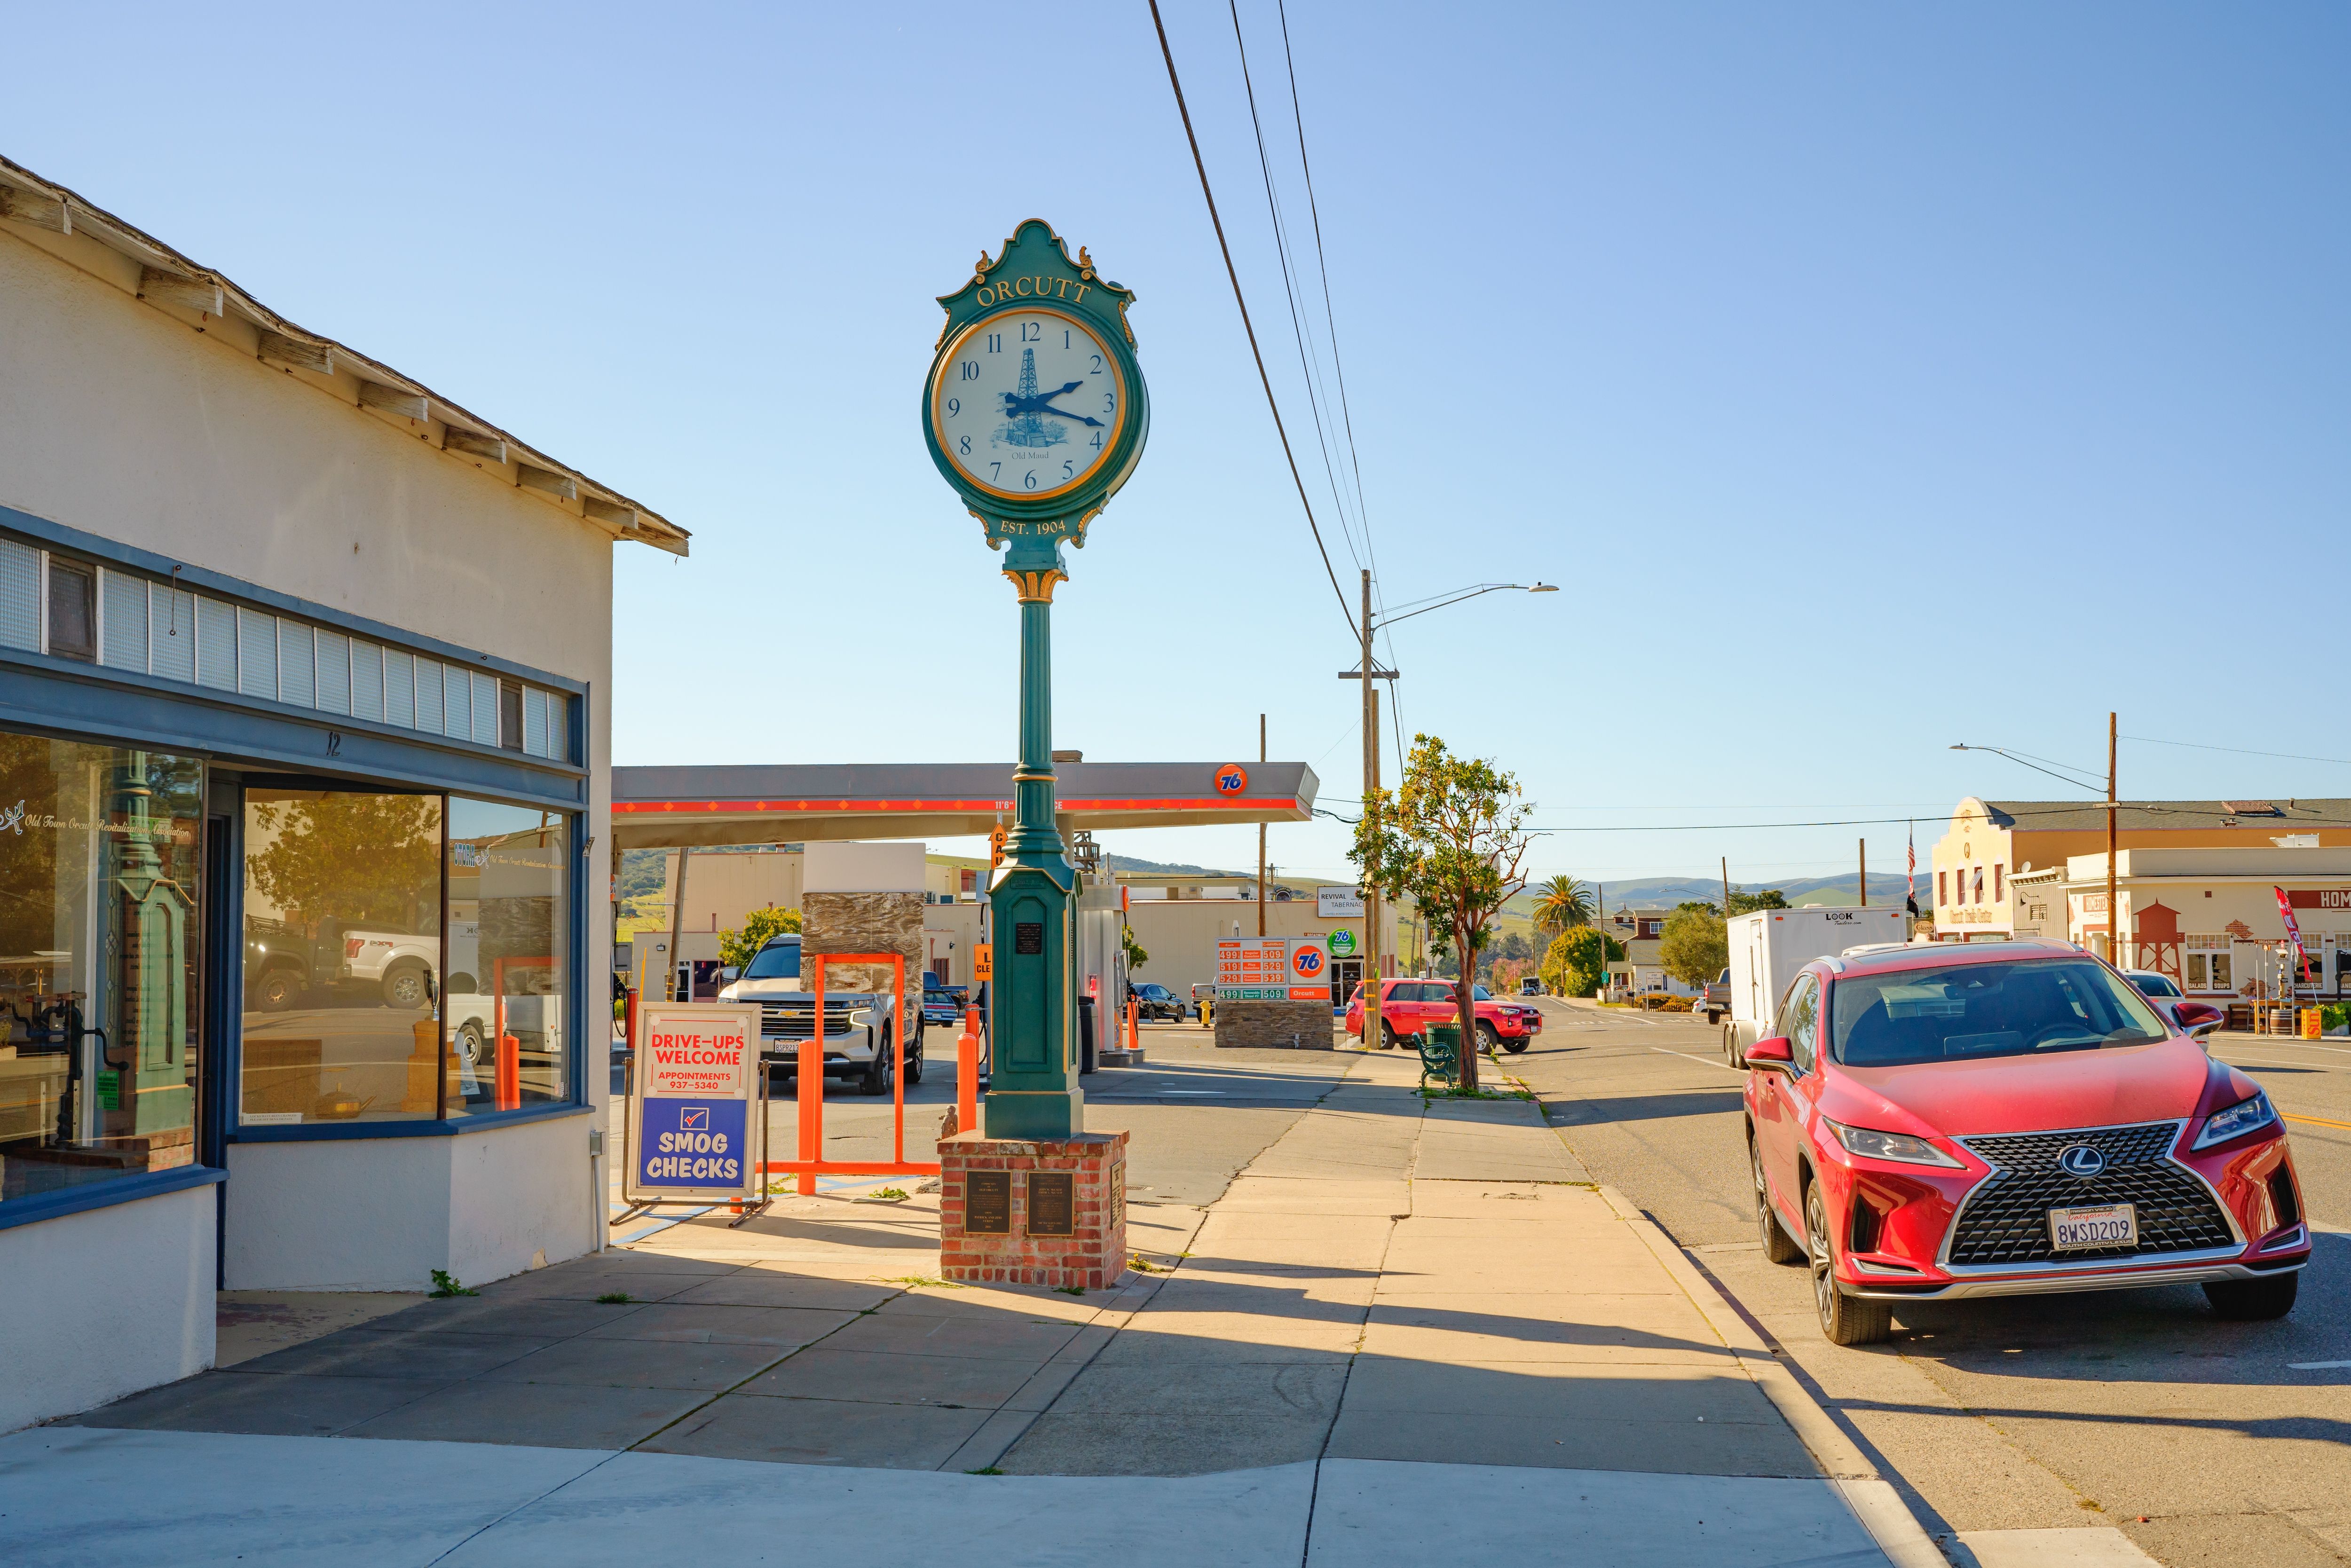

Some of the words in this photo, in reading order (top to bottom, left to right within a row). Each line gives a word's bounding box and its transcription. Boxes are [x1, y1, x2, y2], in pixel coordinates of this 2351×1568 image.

[977, 276, 1091, 307] ORCUTT
[1020, 322, 1041, 342] 12
[1064, 330, 1071, 350] 1
[988, 333, 1002, 354] 11
[961, 361, 979, 381] 10
[1089, 355, 1103, 375] 2
[948, 398, 960, 418] 9
[1103, 393, 1114, 413] 3
[960, 435, 971, 455] 8
[1089, 431, 1103, 451] 4
[1011, 451, 1026, 460] Old
[1028, 451, 1049, 459] Maud
[989, 462, 1002, 482] 7
[1024, 469, 1037, 489] 6
[1063, 460, 1073, 480] 5
[1000, 520, 1030, 535] EST.
[1036, 519, 1066, 536] 1904
[326, 732, 340, 756] 12
[1219, 772, 1242, 790] 76
[25, 814, 41, 827] Old
[43, 815, 66, 828] Town
[68, 817, 94, 830] Orcutt
[95, 819, 148, 834] Revitalization
[147, 823, 190, 837] Association
[454, 843, 475, 867] OTORA
[497, 855, 508, 865] Town
[509, 857, 521, 866] Orcutt
[521, 858, 546, 868] Revitalization
[2086, 895, 2108, 911] HOMESTEA
[1335, 930, 1349, 942] 76
[1297, 952, 1320, 971] 76
[2308, 1012, 2320, 1035] Sun
[652, 1034, 744, 1049] DRIVE-UPS
[655, 1050, 740, 1065] WELCOME
[658, 1072, 731, 1080] APPOINTMENTS
[670, 1081, 718, 1090] 937-5340
[658, 1132, 728, 1154] SMOG
[647, 1156, 738, 1179] CHECKS
[2068, 1212, 2118, 1222] California
[2058, 1220, 2130, 1243] 8WSD209
